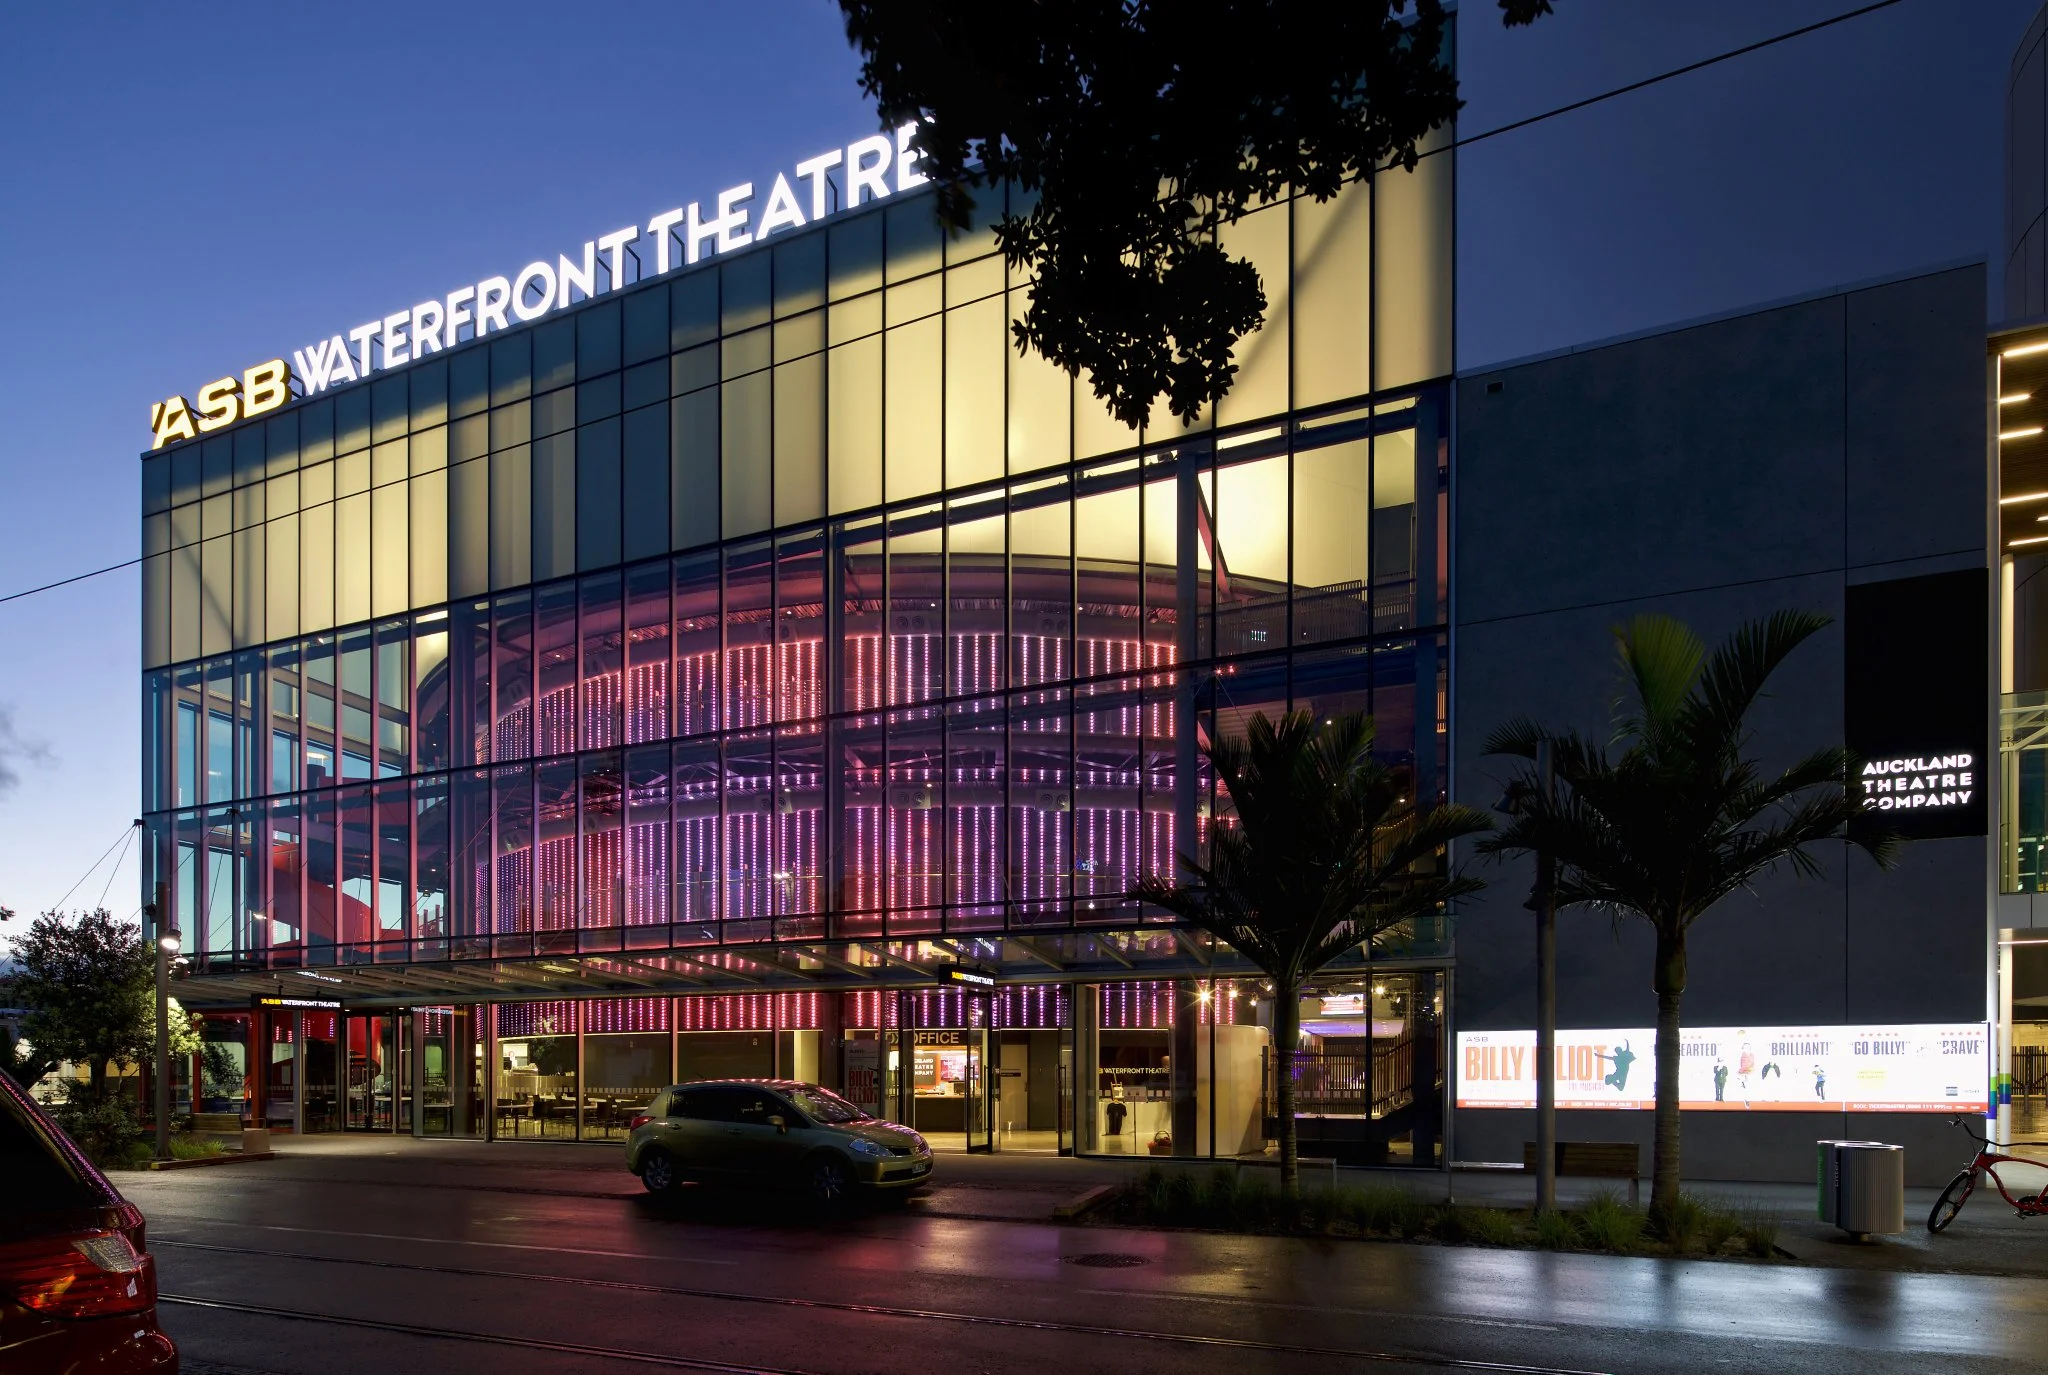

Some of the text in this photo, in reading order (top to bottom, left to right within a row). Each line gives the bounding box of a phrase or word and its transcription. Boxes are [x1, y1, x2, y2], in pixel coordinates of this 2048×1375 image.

[152, 117, 932, 450] ASB WATERFRONT THEATRE
[1861, 753, 1972, 776] AUCKLAND
[1861, 772, 1972, 794] THEATRE
[1861, 791, 1972, 811] COMPANY
[281, 999, 318, 1007] WATERFRONT
[1465, 1045, 1608, 1081] BILLY LIOT
[849, 1070, 874, 1087] BILLY
